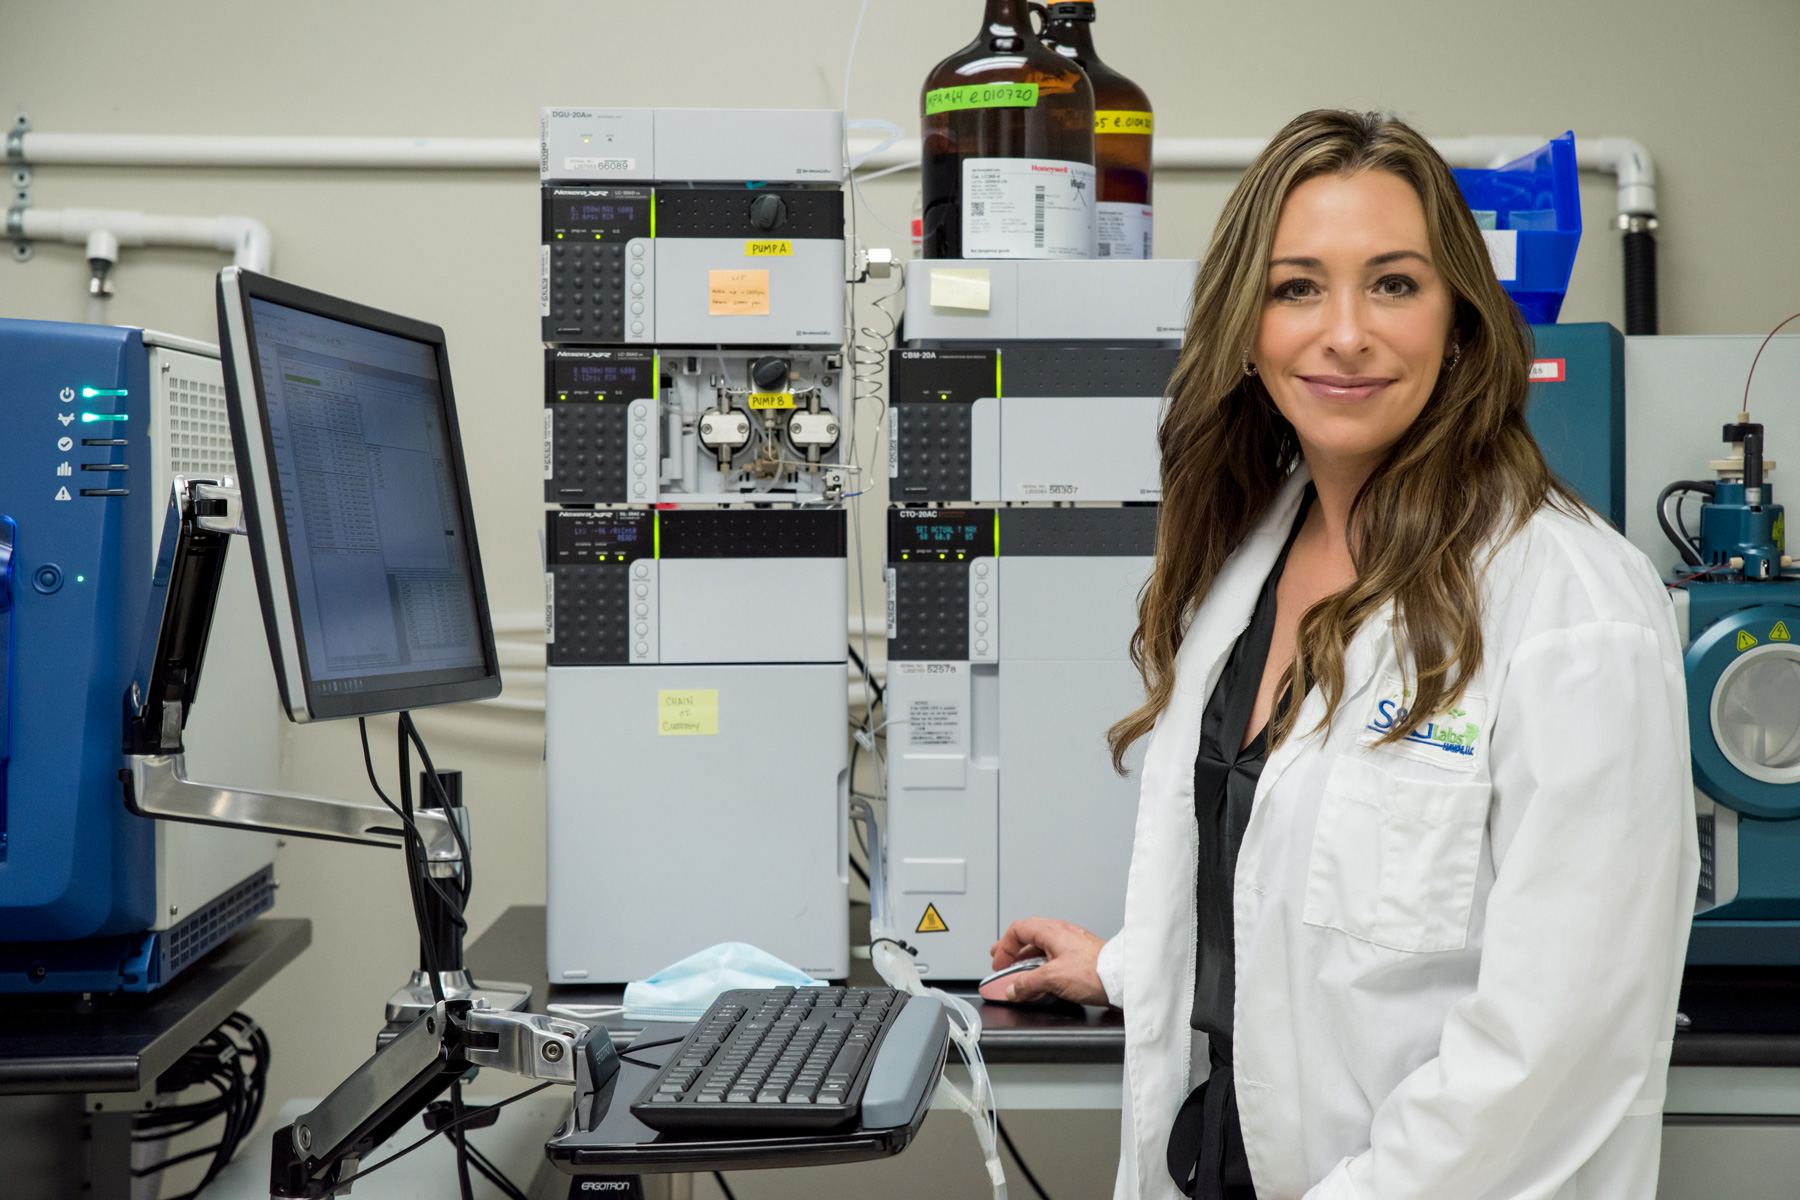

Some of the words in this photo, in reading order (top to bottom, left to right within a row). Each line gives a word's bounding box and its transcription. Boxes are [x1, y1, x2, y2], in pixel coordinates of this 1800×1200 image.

[597, 162, 628, 170] 66089
[1031, 165, 1068, 174] Honeywell
[752, 244, 777, 255] PUMP
[779, 243, 787, 253] A
[752, 396, 775, 407] PUMP
[777, 395, 785, 407] B
[1049, 486, 1078, 494] 56307
[927, 665, 957, 673] 52578
[665, 696, 694, 706] CHAIN
[1432, 724, 1465, 745] Labs
[581, 1181, 630, 1190] ERGOTRON
